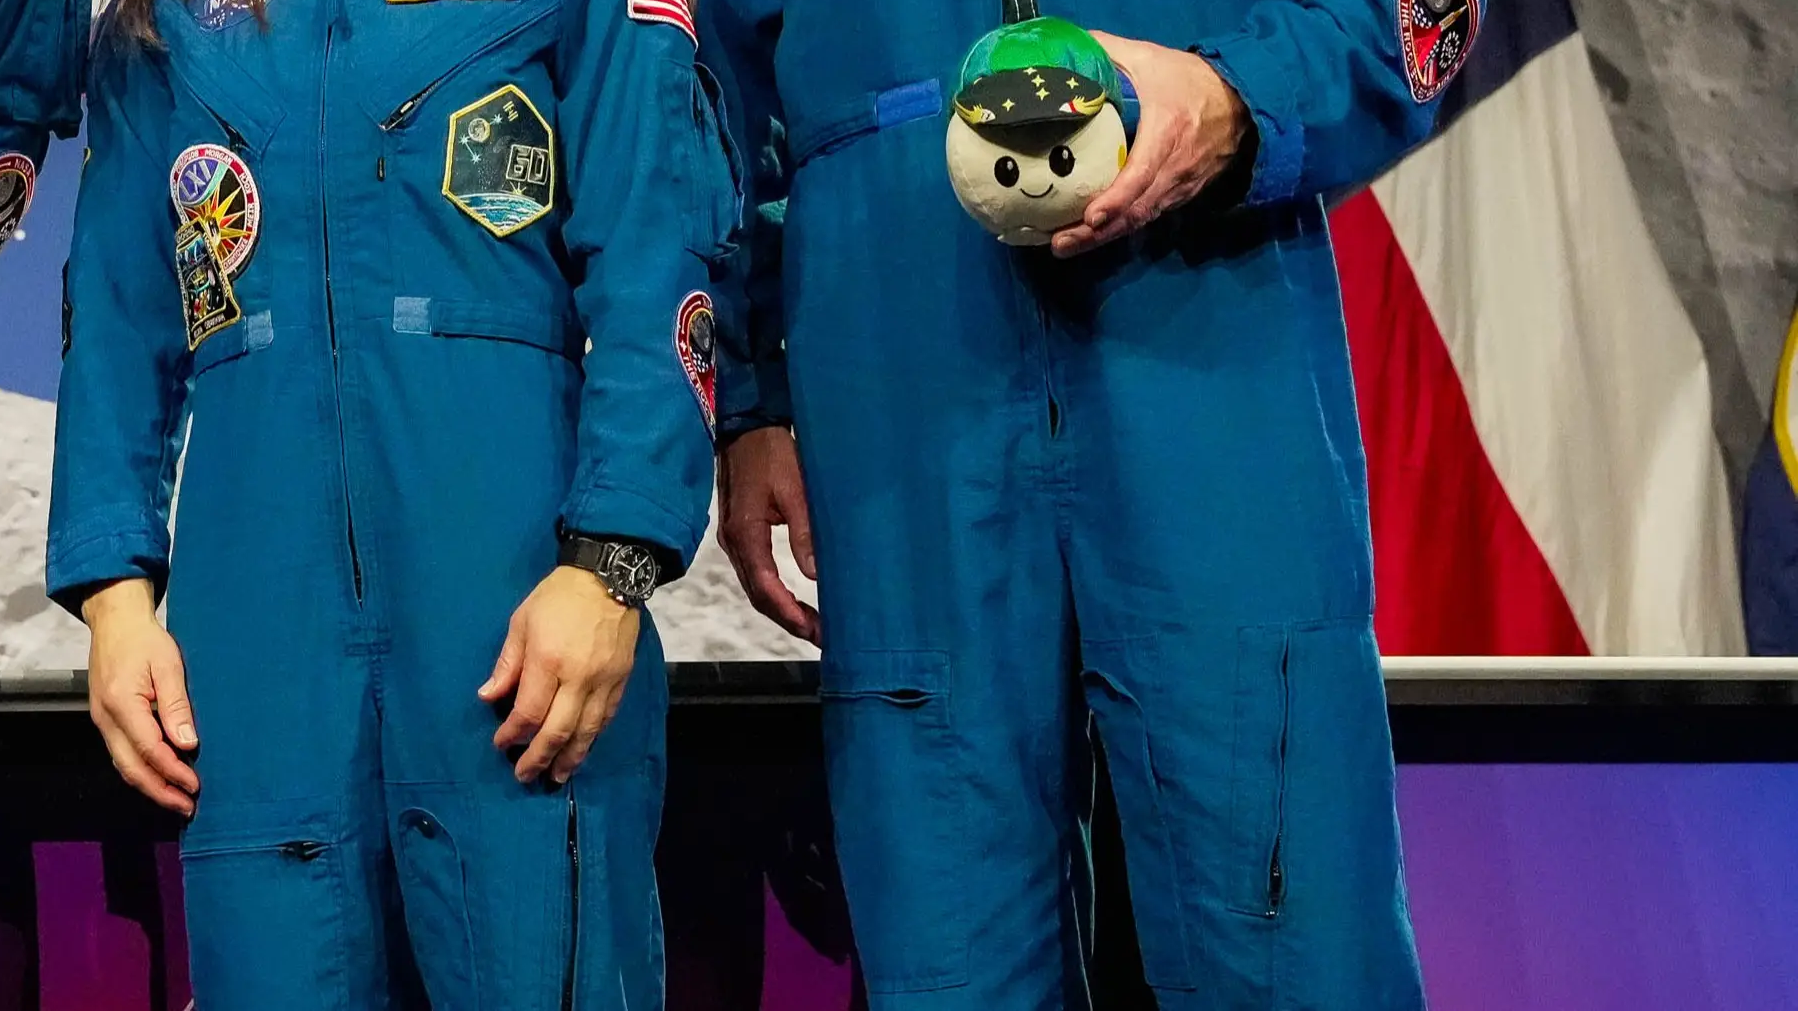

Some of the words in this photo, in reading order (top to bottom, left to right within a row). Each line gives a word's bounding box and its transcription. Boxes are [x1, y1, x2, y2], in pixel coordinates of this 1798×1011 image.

[1401, 2, 1410, 27] THE
[14, 158, 33, 178] NASA
[204, 148, 233, 165] MORGAN
[506, 144, 549, 186] 60
[179, 159, 212, 201] LXI
[683, 356, 698, 381] THE
